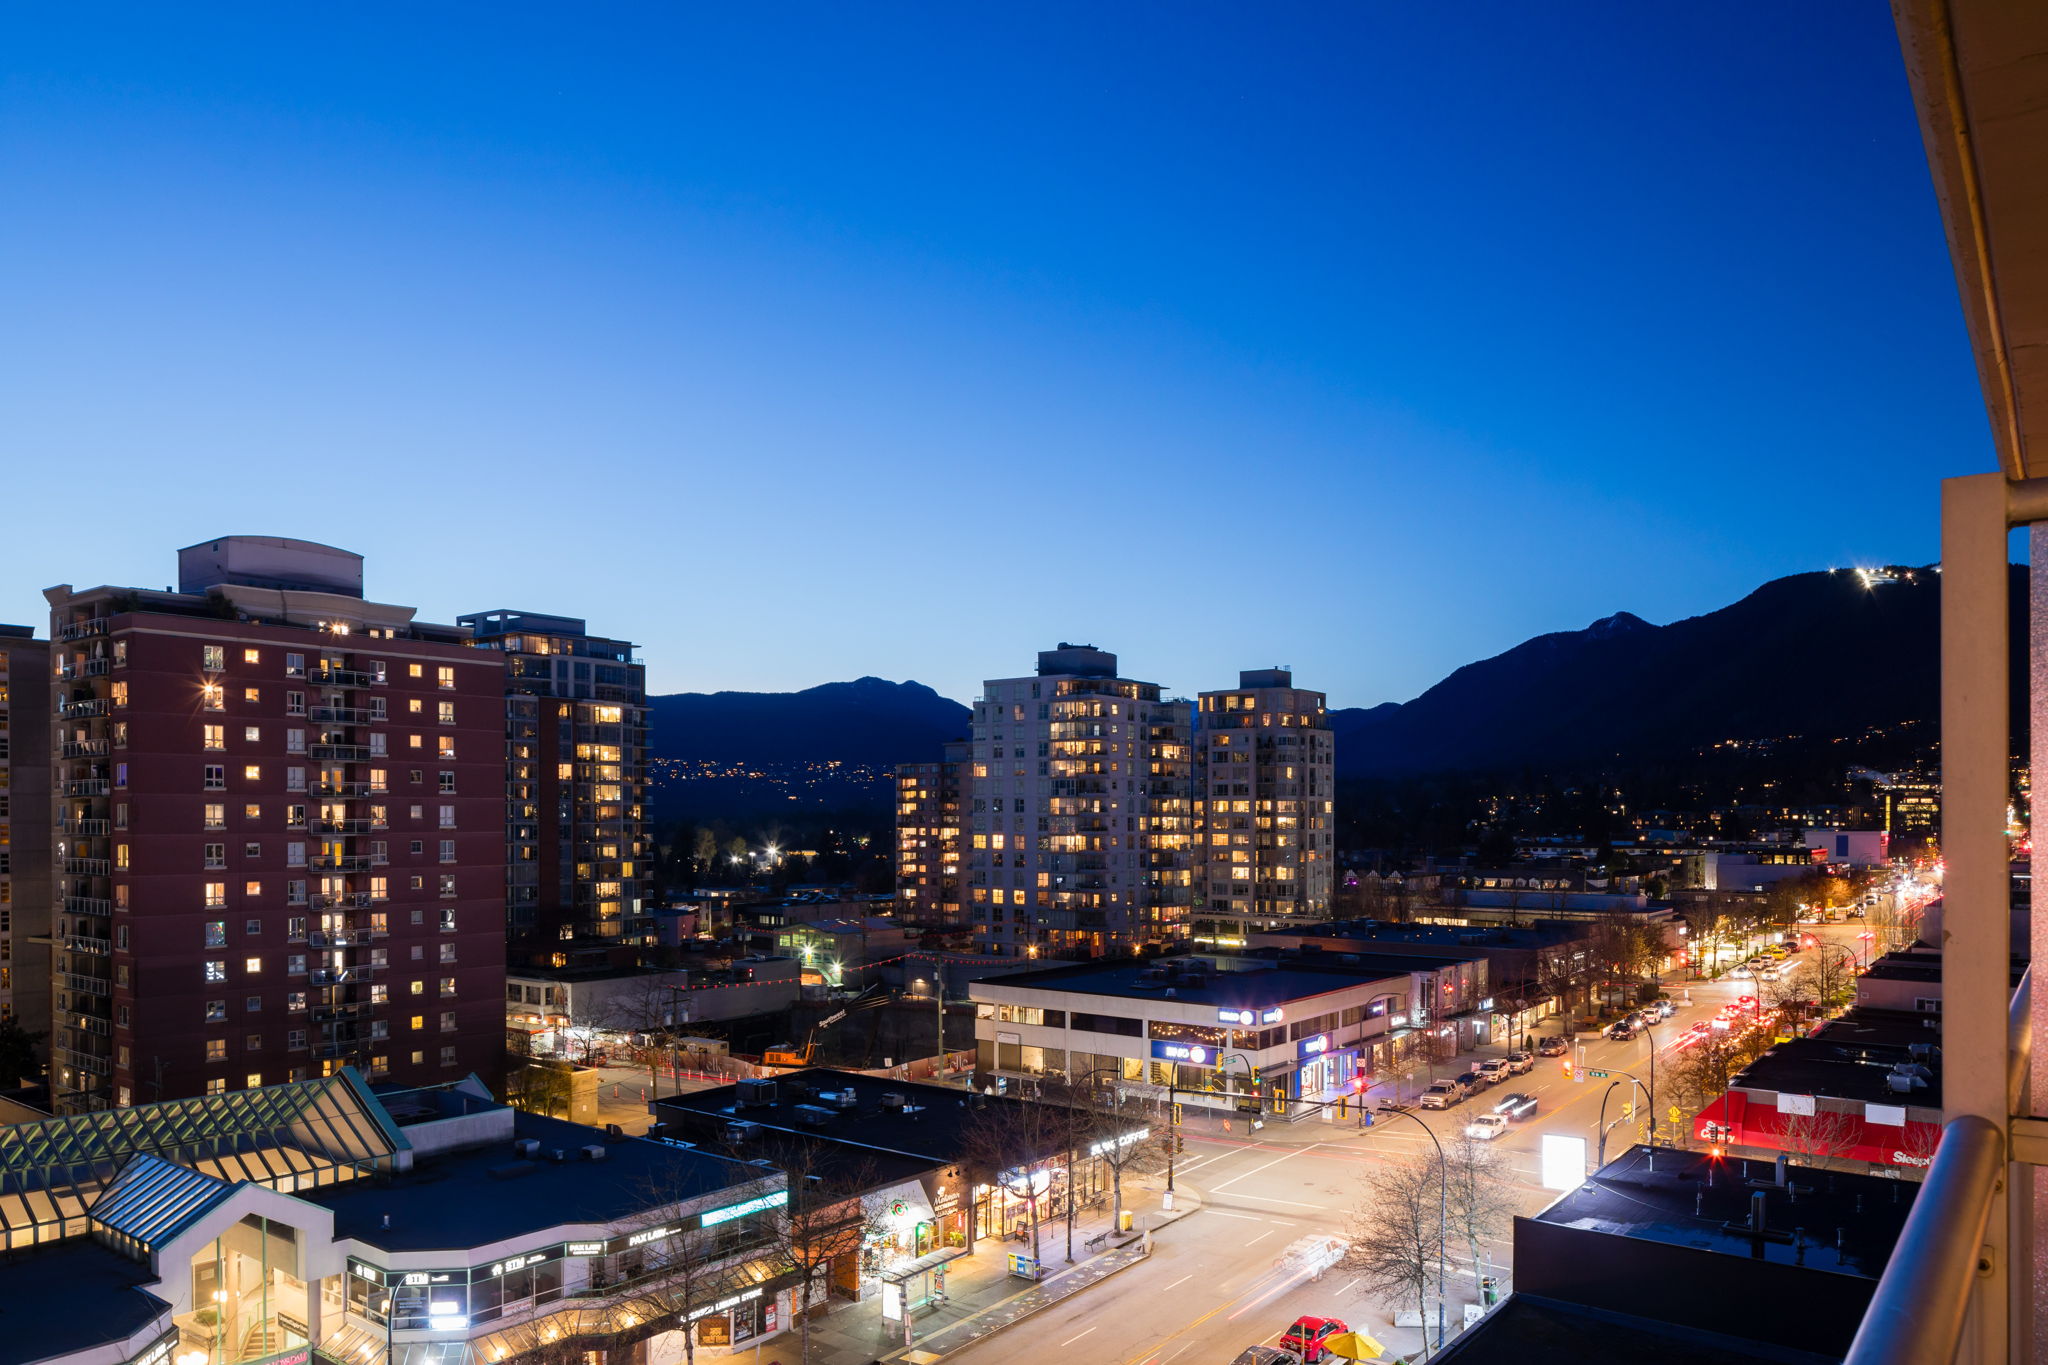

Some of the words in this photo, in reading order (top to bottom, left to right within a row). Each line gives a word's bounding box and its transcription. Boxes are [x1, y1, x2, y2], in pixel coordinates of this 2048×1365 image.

[1119, 1128, 1150, 1146] COFFEE
[629, 1234, 647, 1246] PAX
[648, 1228, 667, 1241] LAW
[569, 1244, 584, 1252] PAX
[715, 1296, 740, 1310] LIQUOR
[741, 1288, 763, 1302] STORE
